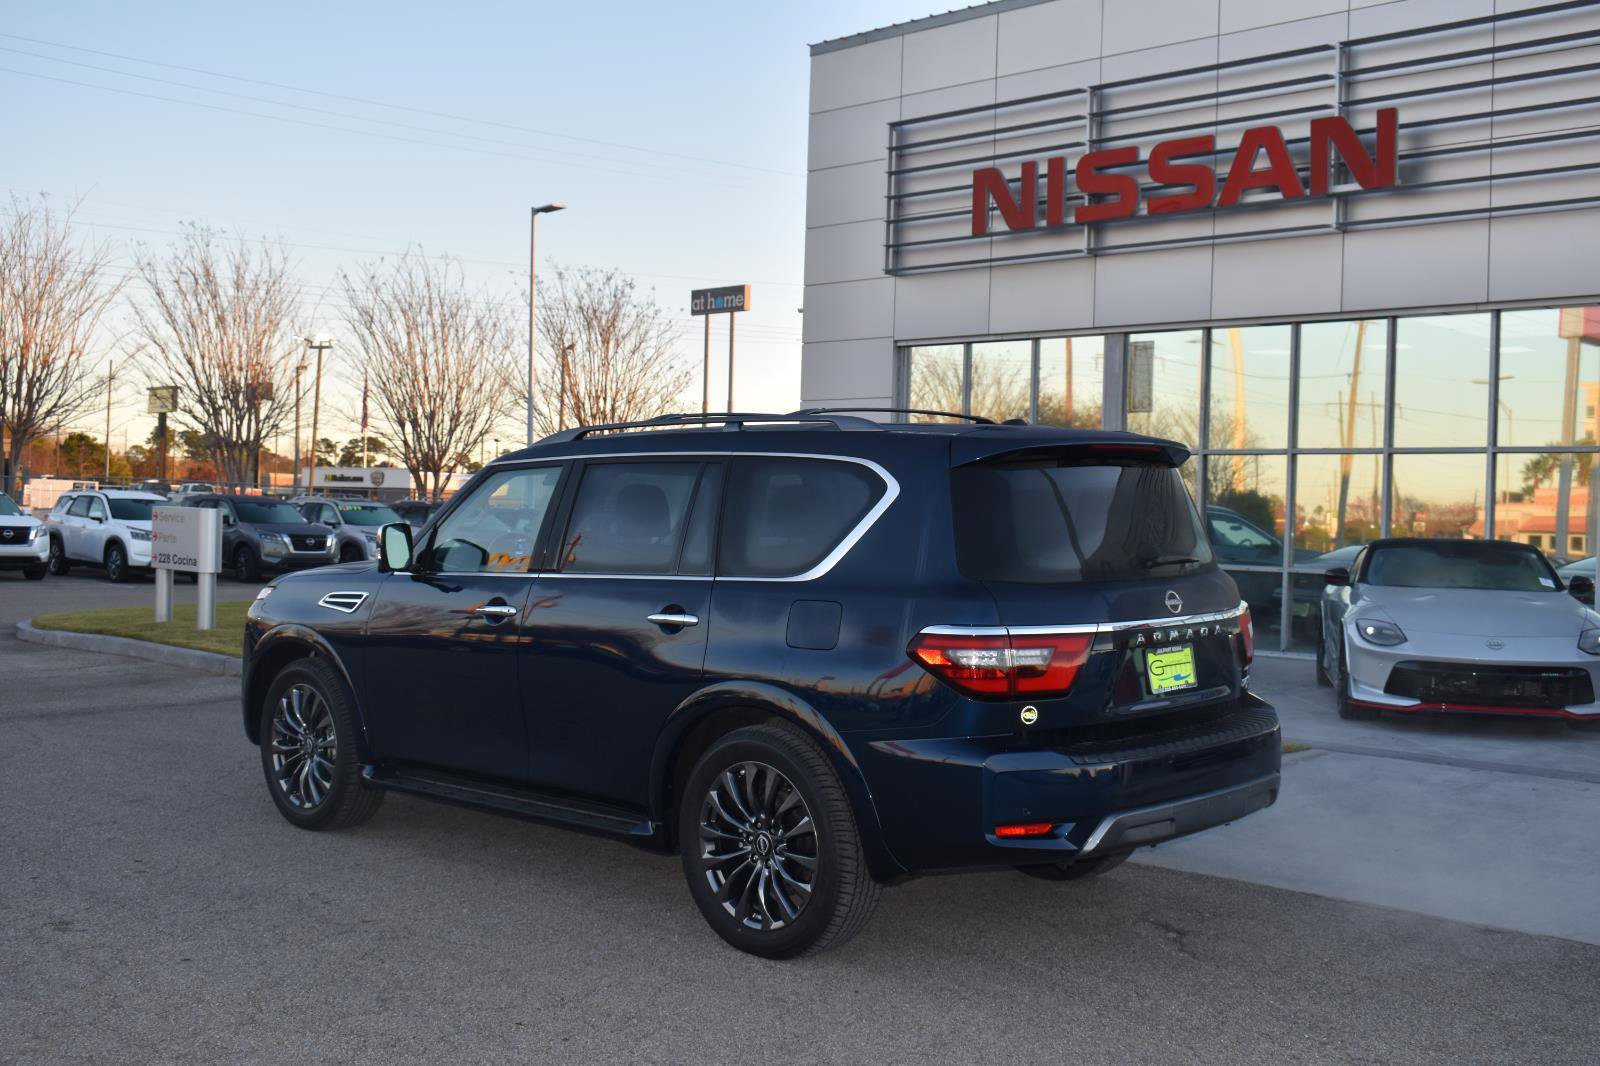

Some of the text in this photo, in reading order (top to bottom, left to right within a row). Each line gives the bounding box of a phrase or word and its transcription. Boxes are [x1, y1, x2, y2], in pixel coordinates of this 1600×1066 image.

[971, 107, 1398, 236] NISSAN
[692, 292, 744, 310] at home
[159, 511, 185, 524] Service
[158, 553, 197, 566] 228 Cocina
[1136, 624, 1221, 647] ARMADA
